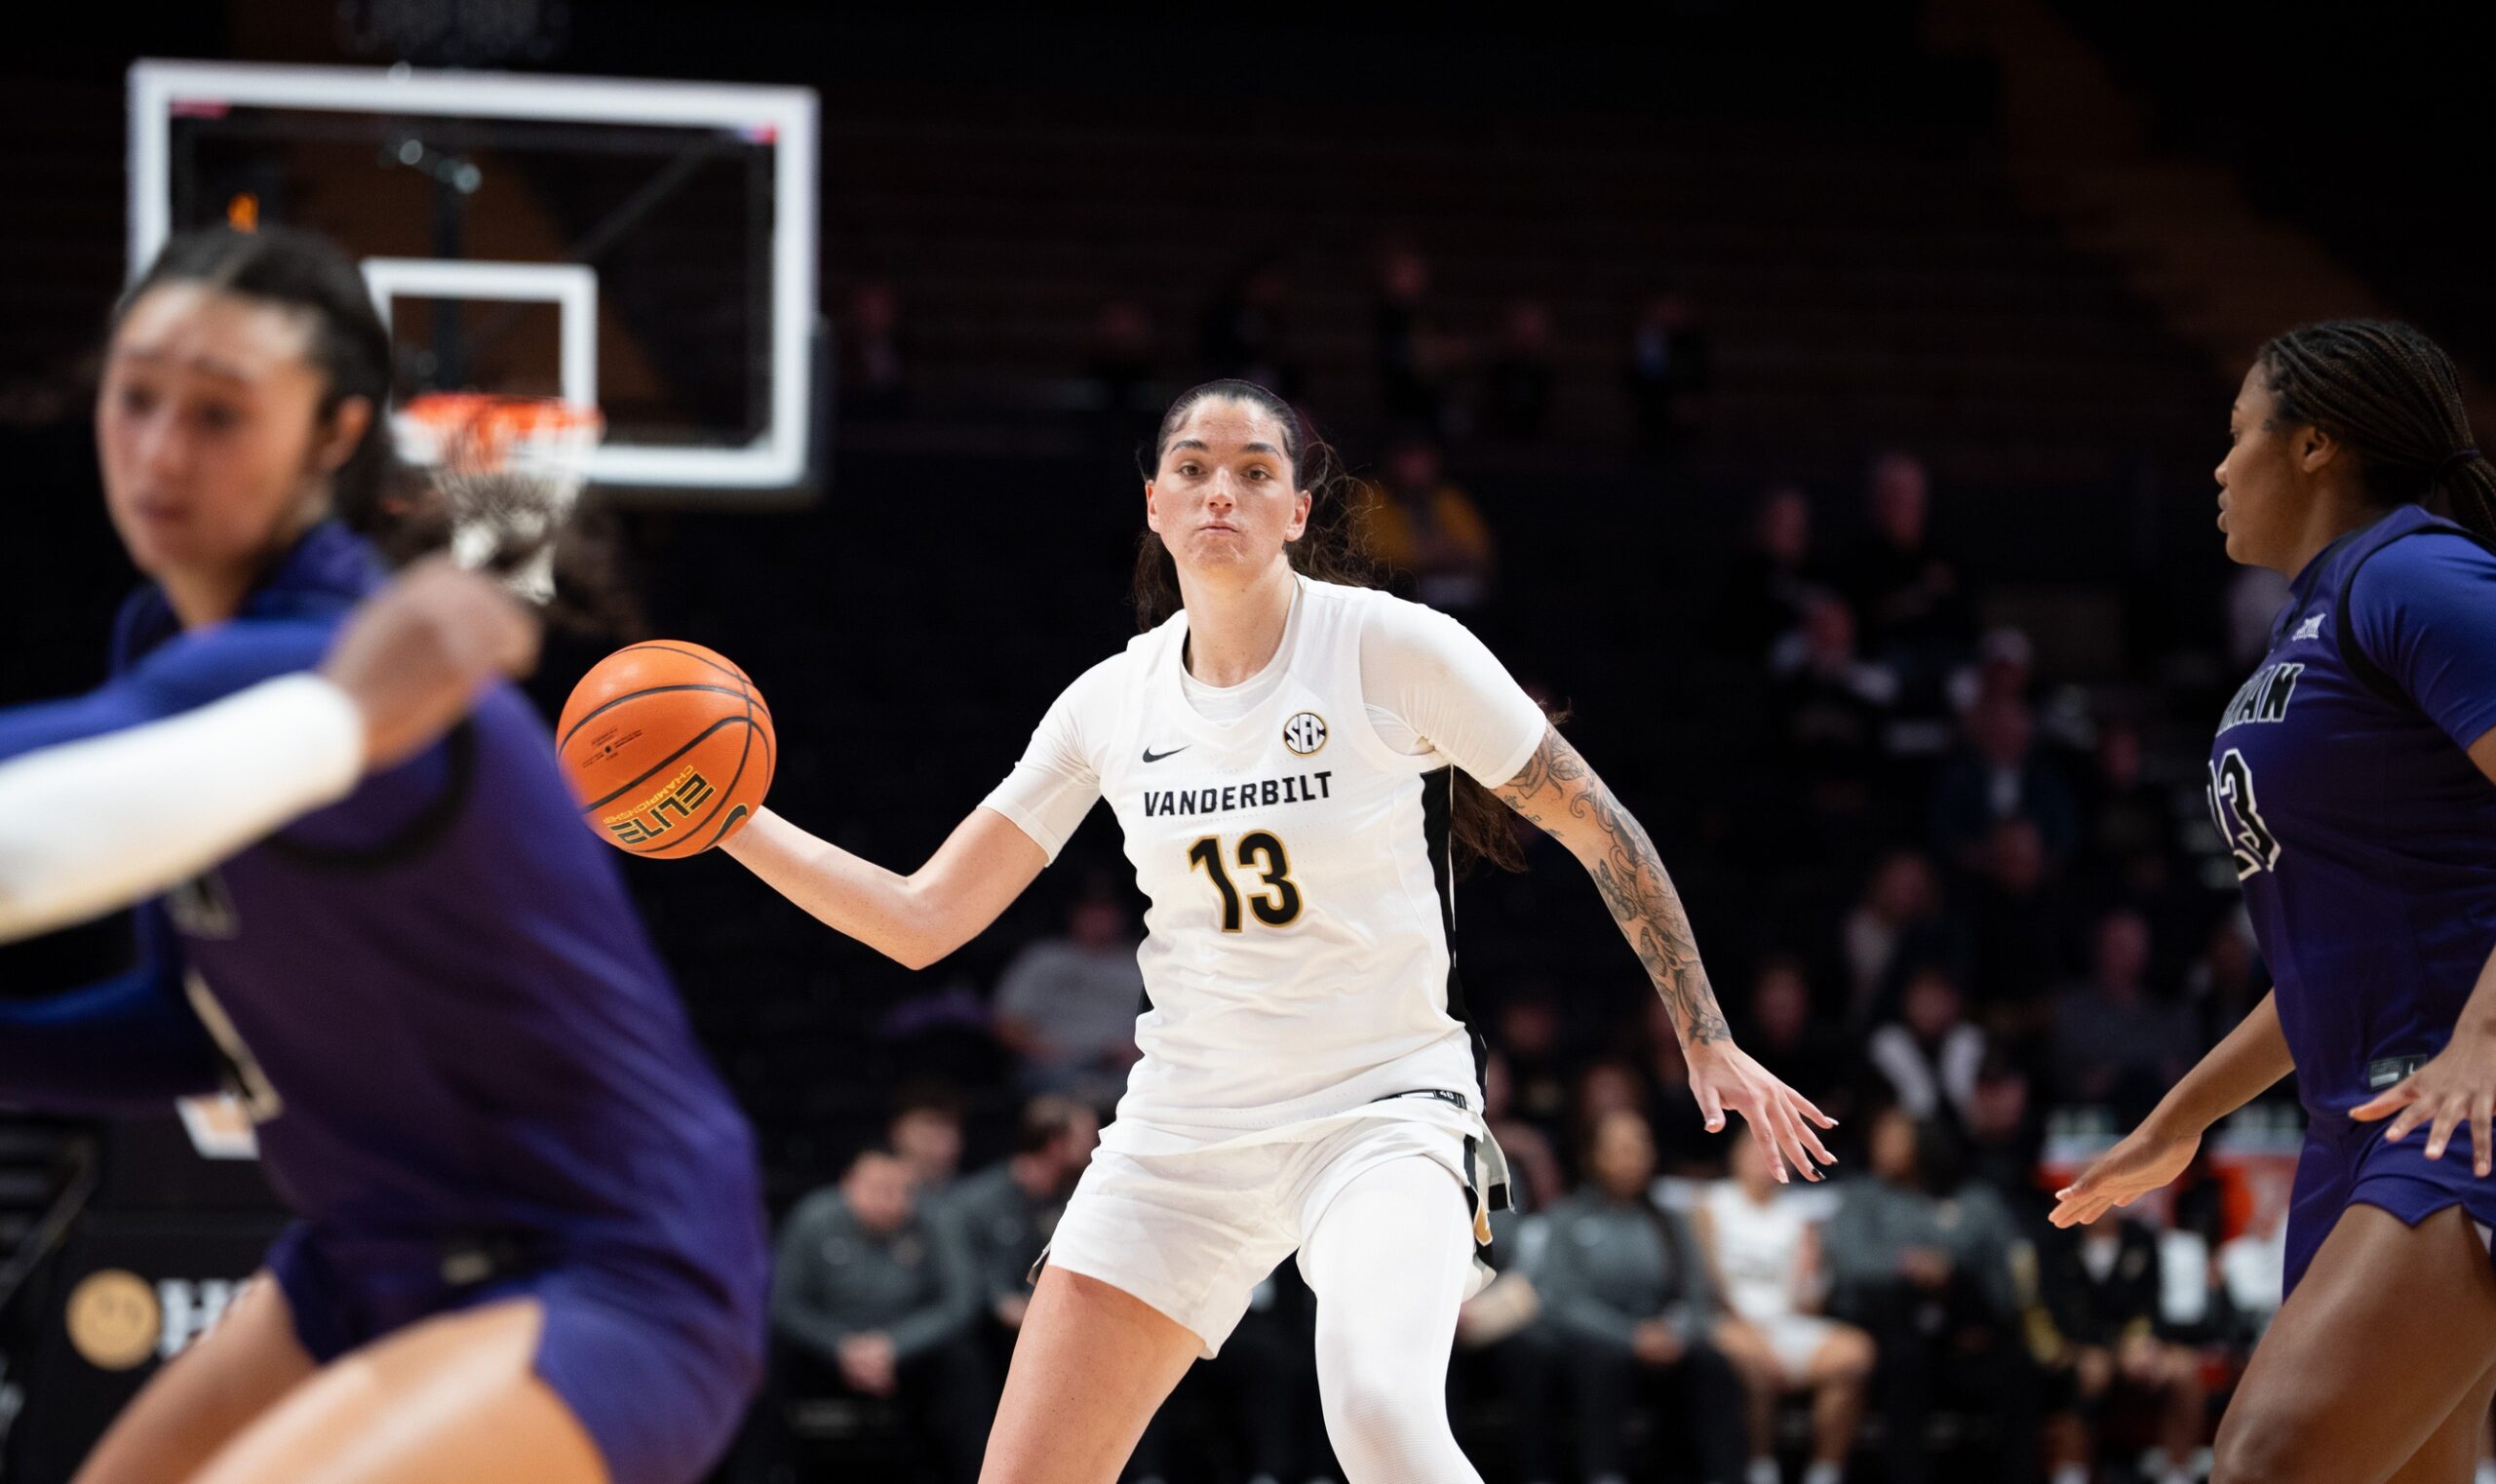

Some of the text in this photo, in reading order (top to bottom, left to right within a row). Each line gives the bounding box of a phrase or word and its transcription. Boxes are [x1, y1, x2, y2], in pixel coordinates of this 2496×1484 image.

[1283, 712, 1327, 755] SEC
[607, 771, 717, 844] ELITE
[1144, 771, 1332, 817] VANDERBILT
[1187, 829, 1304, 933] 13
